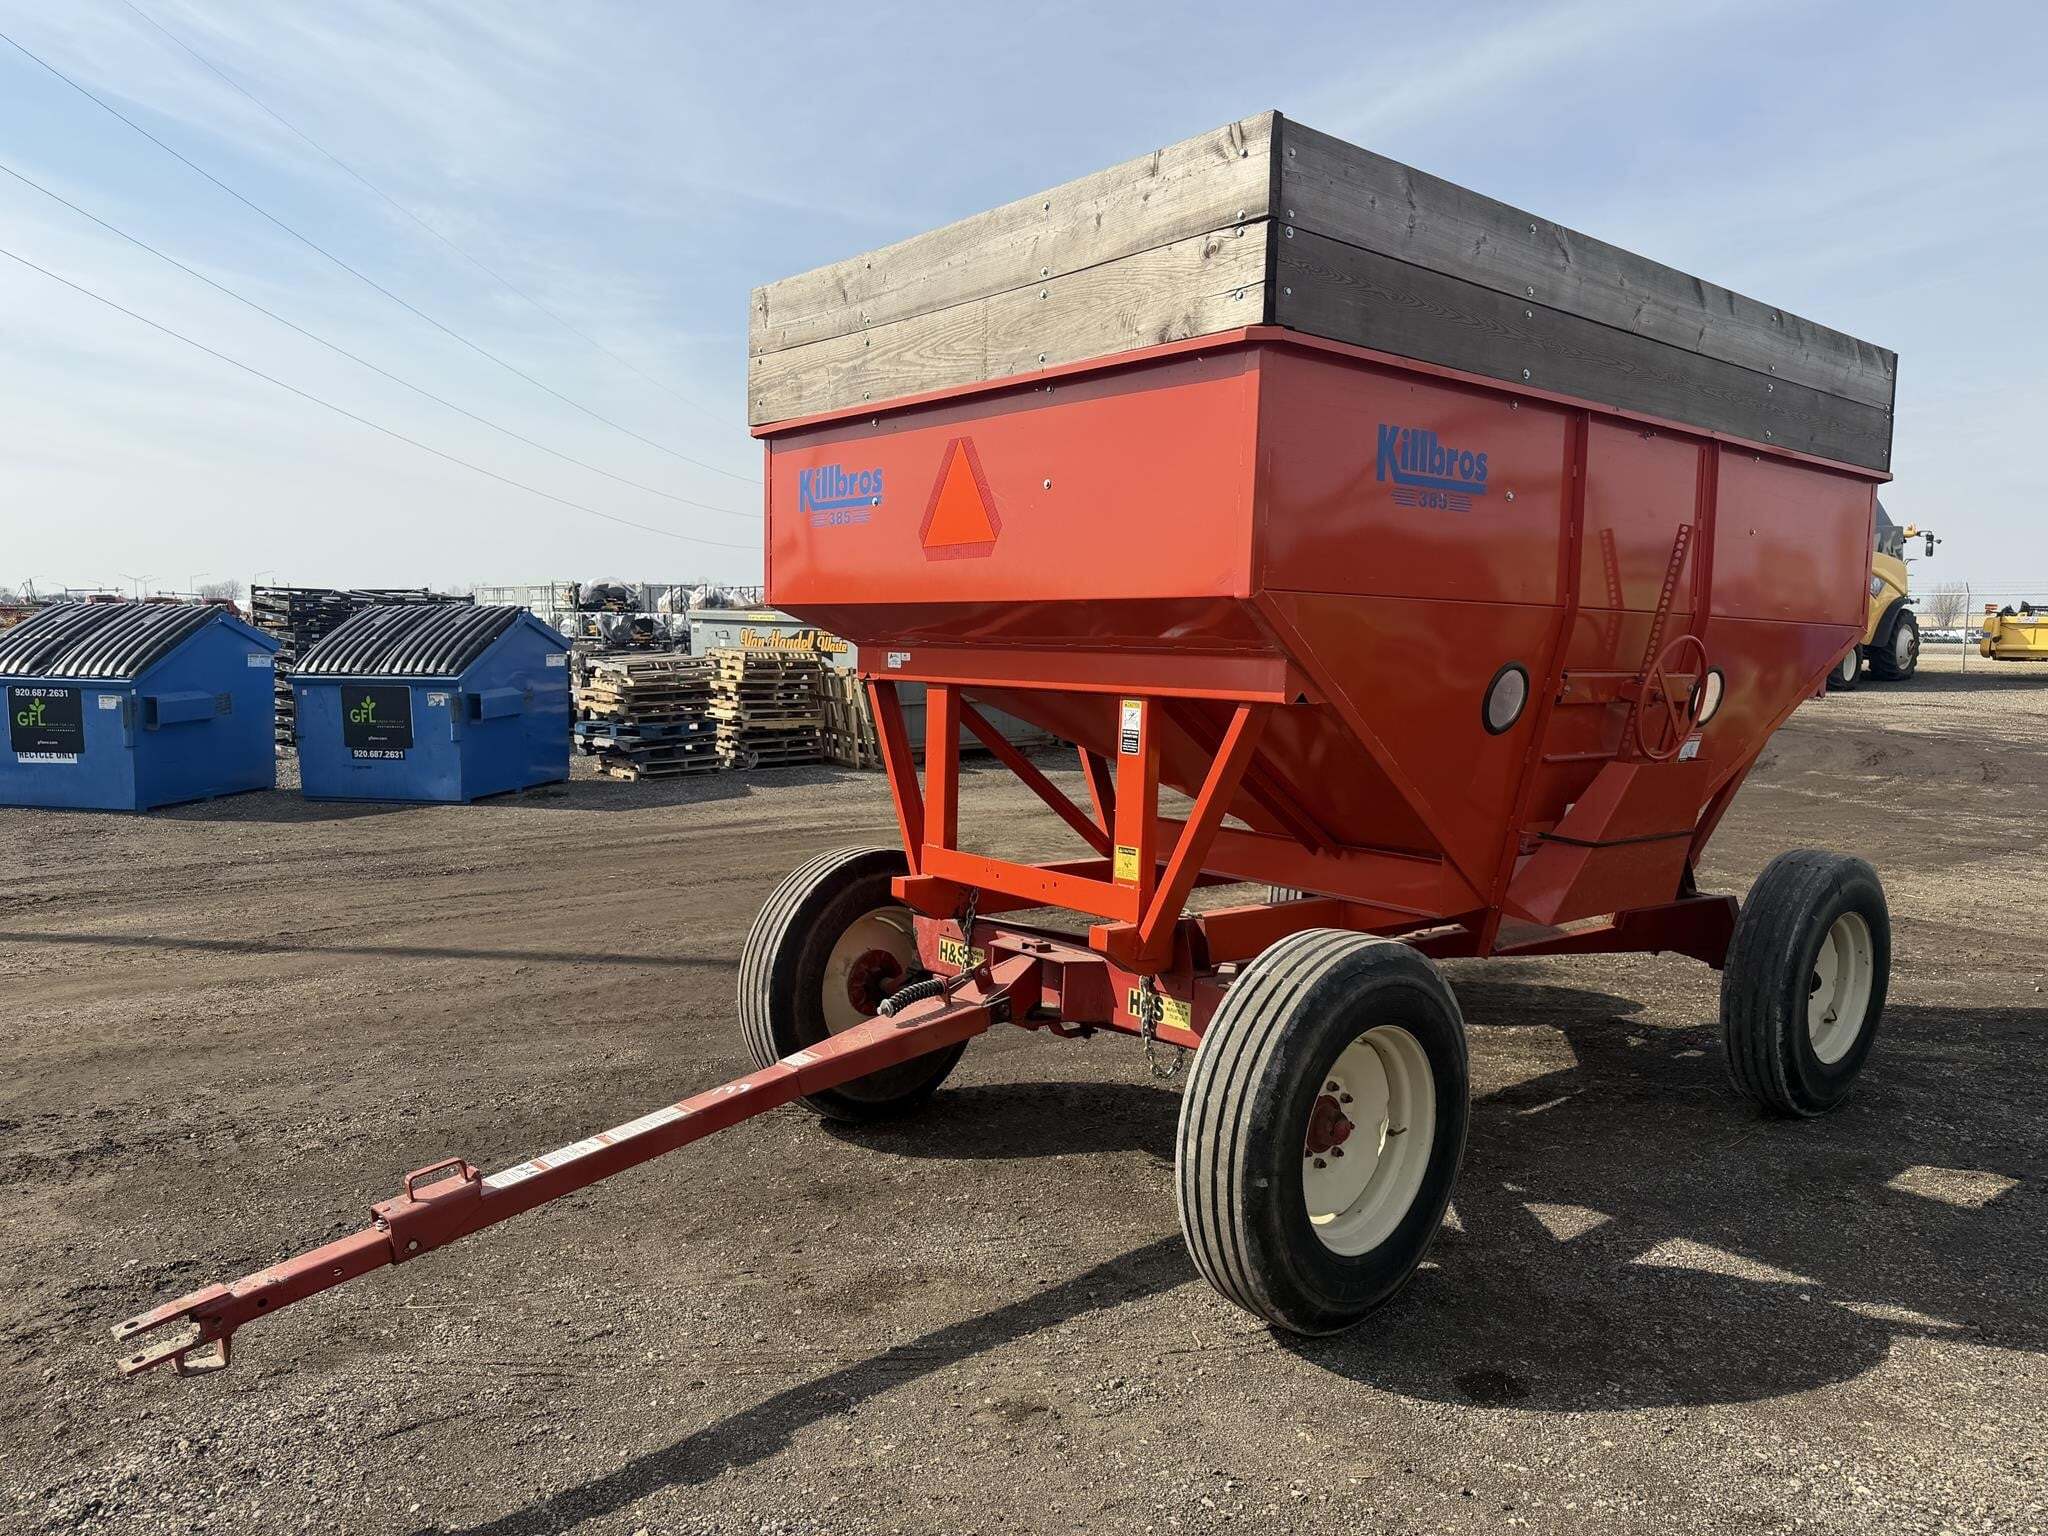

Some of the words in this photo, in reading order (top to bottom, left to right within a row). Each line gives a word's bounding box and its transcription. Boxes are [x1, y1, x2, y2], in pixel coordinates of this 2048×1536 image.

[1376, 423, 1488, 484] Killbros
[799, 464, 884, 512] Killbros
[1418, 490, 1448, 509] 385
[828, 511, 851, 526] 385
[740, 628, 766, 648] Van
[766, 628, 815, 651] Handel
[816, 636, 849, 653] Waste
[15, 688, 69, 698] 920.687.2631
[17, 708, 46, 726] GFL
[350, 705, 376, 723] GFL
[353, 750, 404, 759] 920.687.2631
[1130, 990, 1164, 1021] HS
